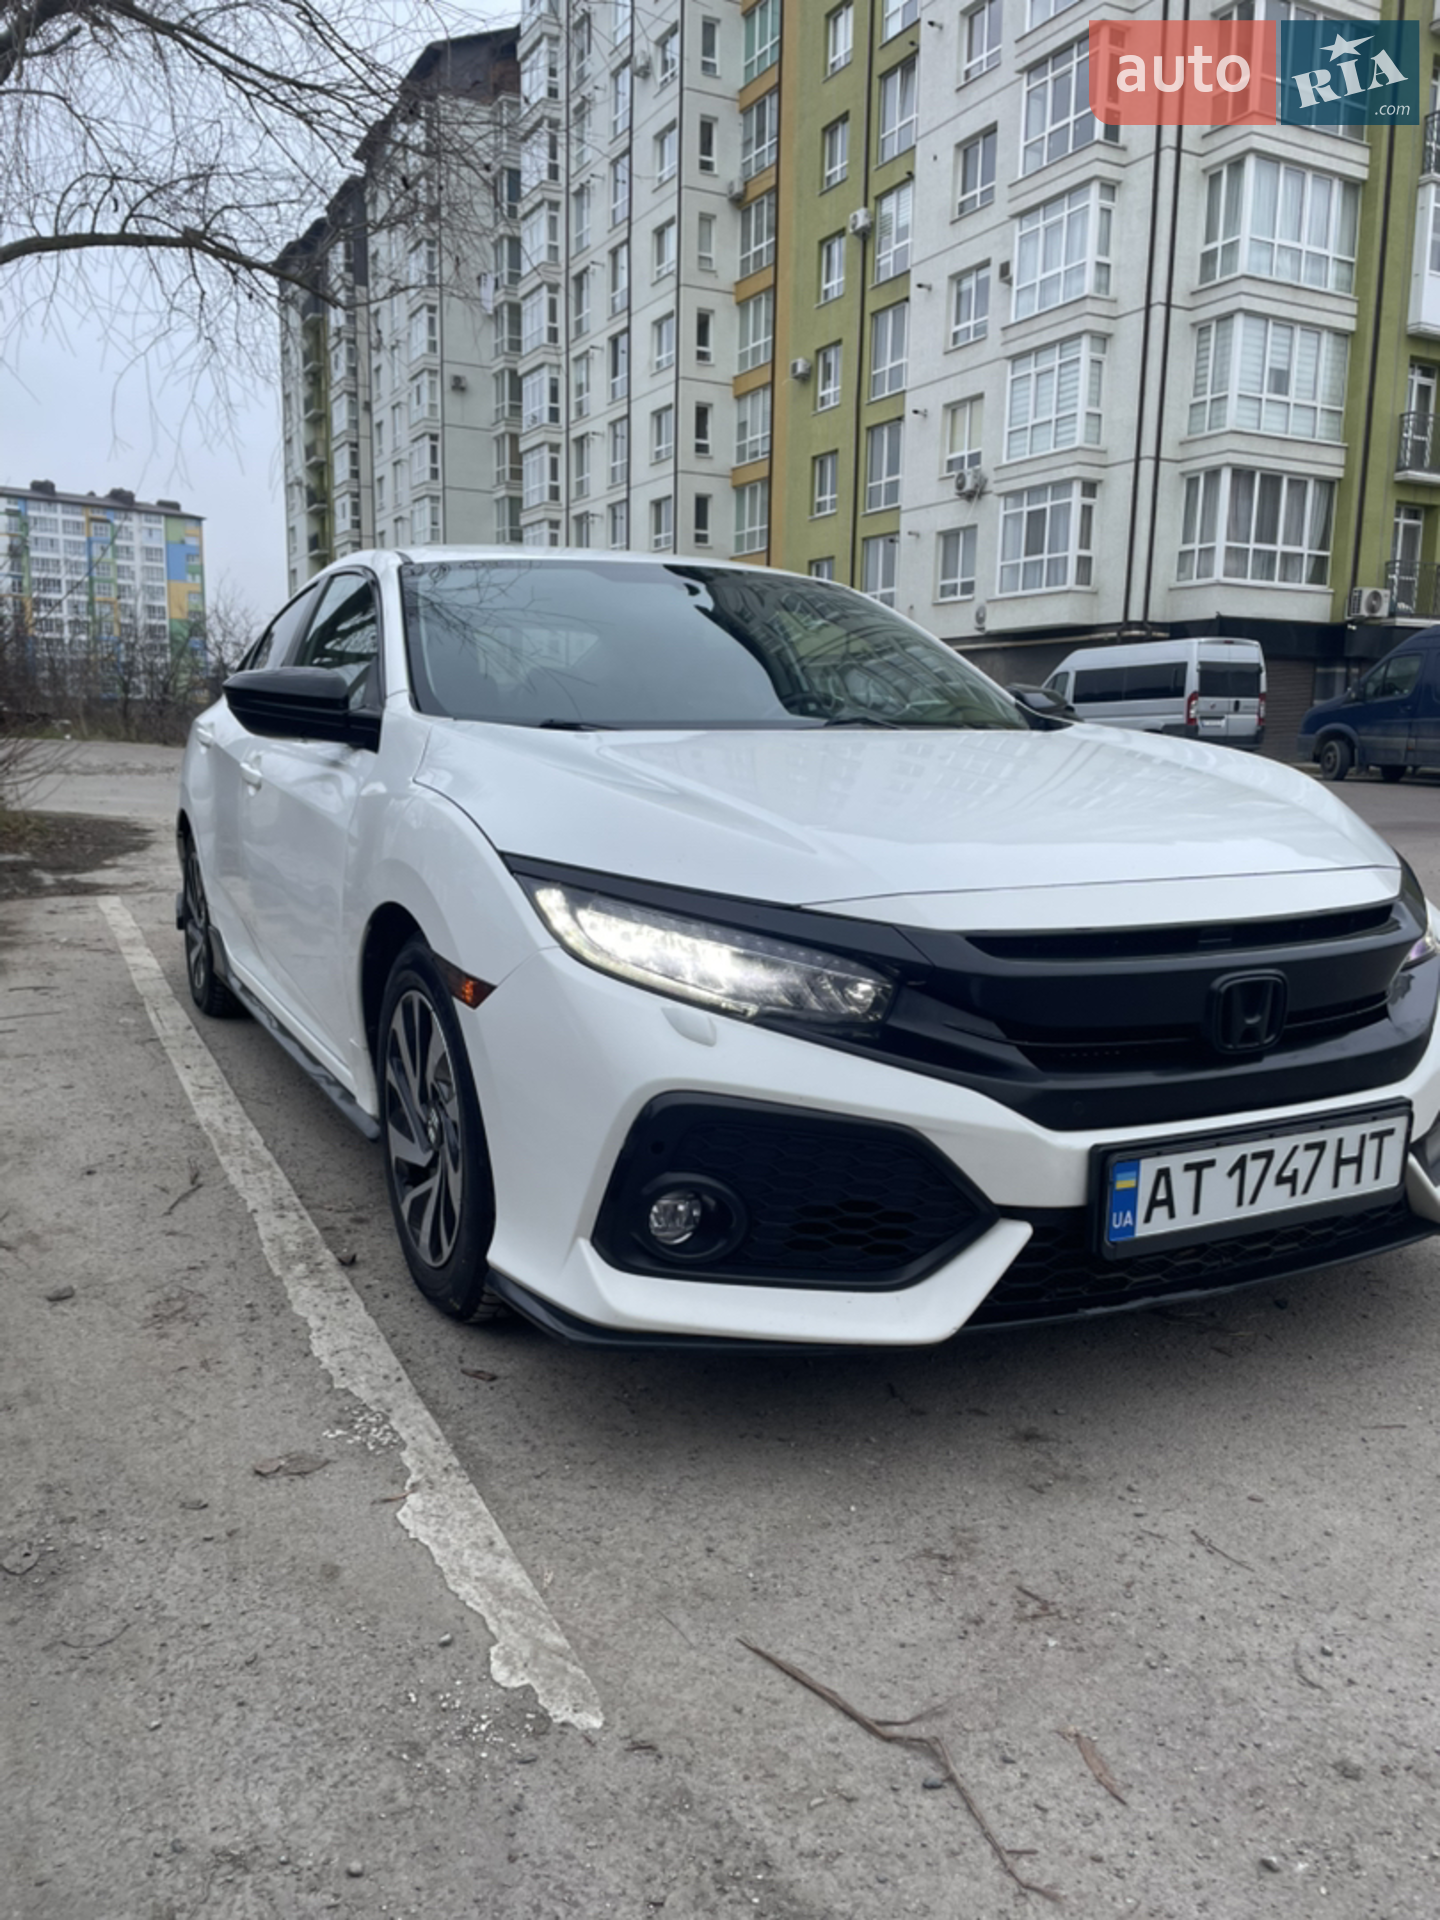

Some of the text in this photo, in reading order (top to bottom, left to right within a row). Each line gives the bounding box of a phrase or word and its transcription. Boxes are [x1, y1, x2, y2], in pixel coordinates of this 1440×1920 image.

[1143, 1159, 1216, 1224] AT
[1226, 1140, 1327, 1208] 1747
[1112, 1210, 1134, 1229] UA
